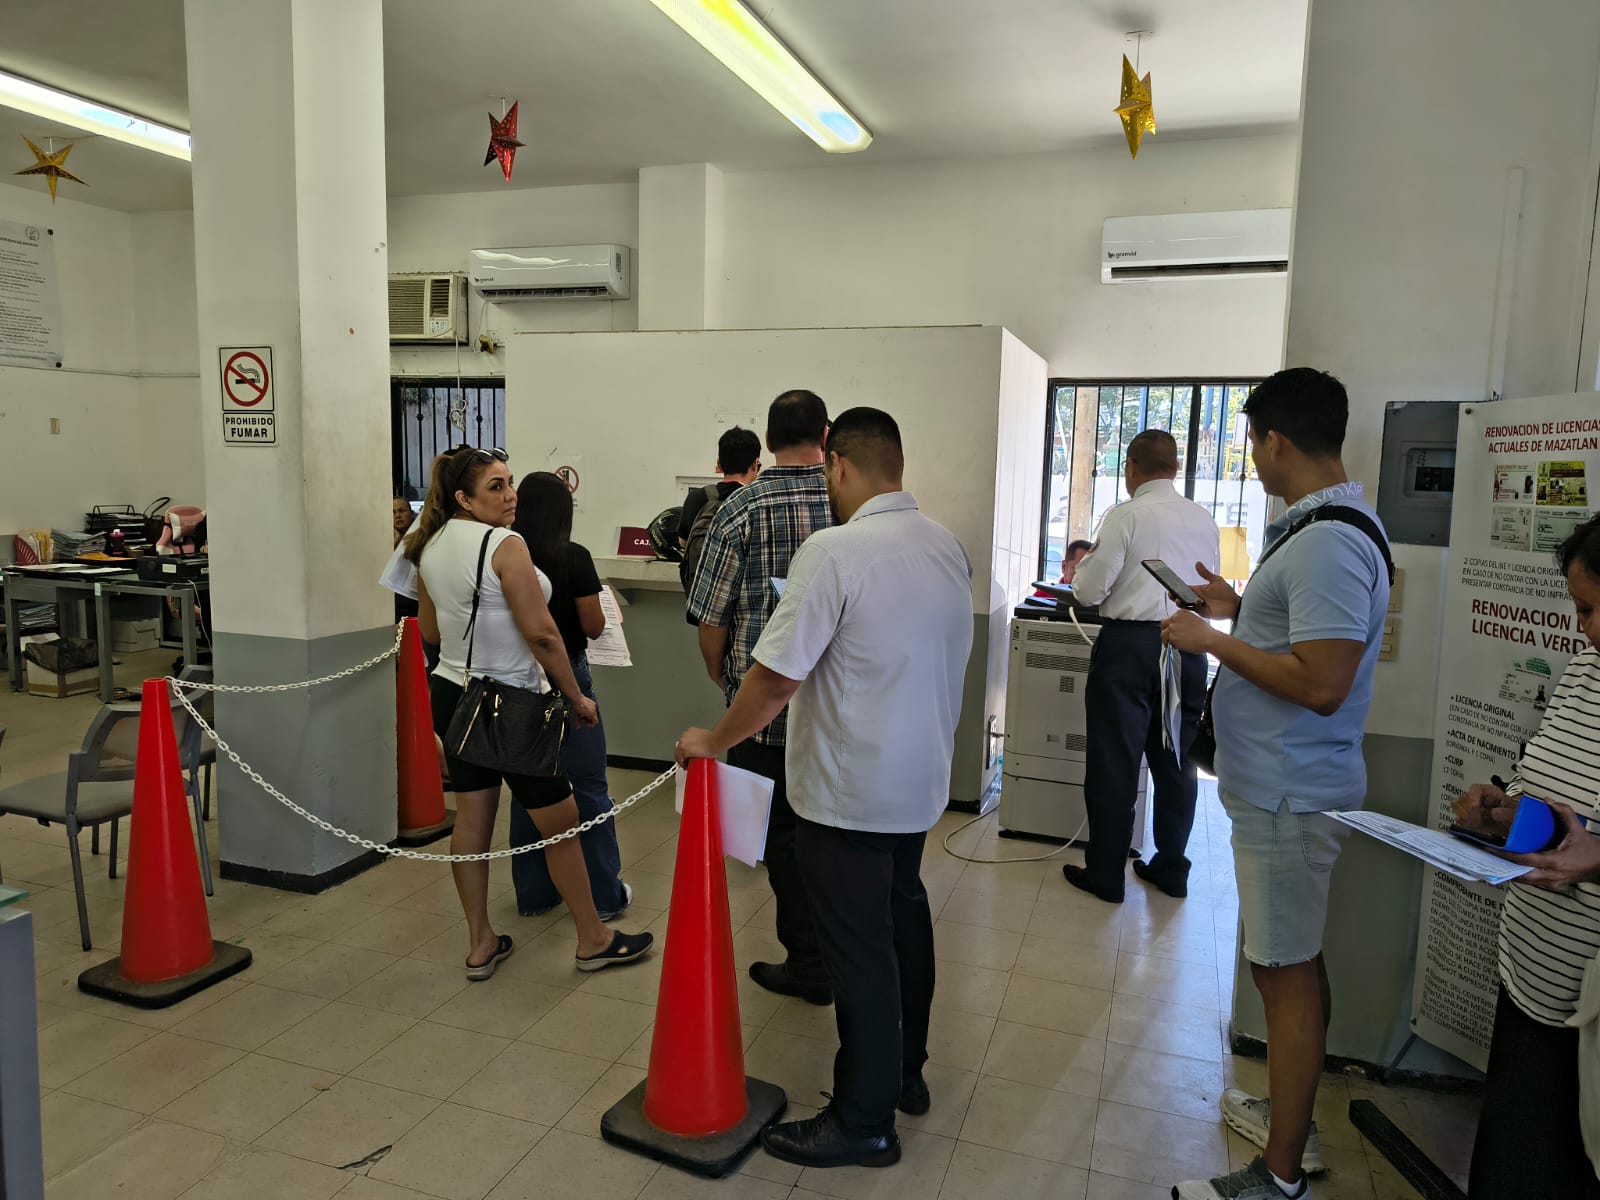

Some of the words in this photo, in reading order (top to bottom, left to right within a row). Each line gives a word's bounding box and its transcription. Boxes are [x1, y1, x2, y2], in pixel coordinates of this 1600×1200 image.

[225, 417, 272, 425] PROHIBIDO
[231, 428, 268, 437] FUMAR
[1485, 424, 1539, 438] RENOVACION
[1542, 423, 1553, 434] DE
[1488, 441, 1528, 453] ACTUALES
[1531, 441, 1542, 452] DE
[1545, 437, 1597, 451] MAZATLAN
[1512, 563, 1535, 573] LICENCIA
[1472, 569, 1486, 577] CASO
[1487, 571, 1494, 579] DE
[1503, 574, 1524, 582] CONTAR
[1525, 575, 1538, 585] CON
[1540, 578, 1549, 587] LA
[1462, 578, 1492, 588] PRESENTAR
[1493, 582, 1524, 594] CONSTANCIA
[1525, 587, 1534, 596] DE
[1472, 599, 1571, 631] RENOVACION
[1472, 619, 1536, 646] LICENCIA
[1541, 632, 1591, 655] VERD
[1455, 694, 1482, 709] LICENCIA
[1484, 703, 1515, 720] ORIGINAL
[1449, 714, 1479, 729] CONSTANCIA
[1450, 730, 1465, 741] ACTA
[1468, 736, 1476, 745] DE
[1477, 740, 1516, 760] NACIMIENTO
[1484, 898, 1496, 909] DE
